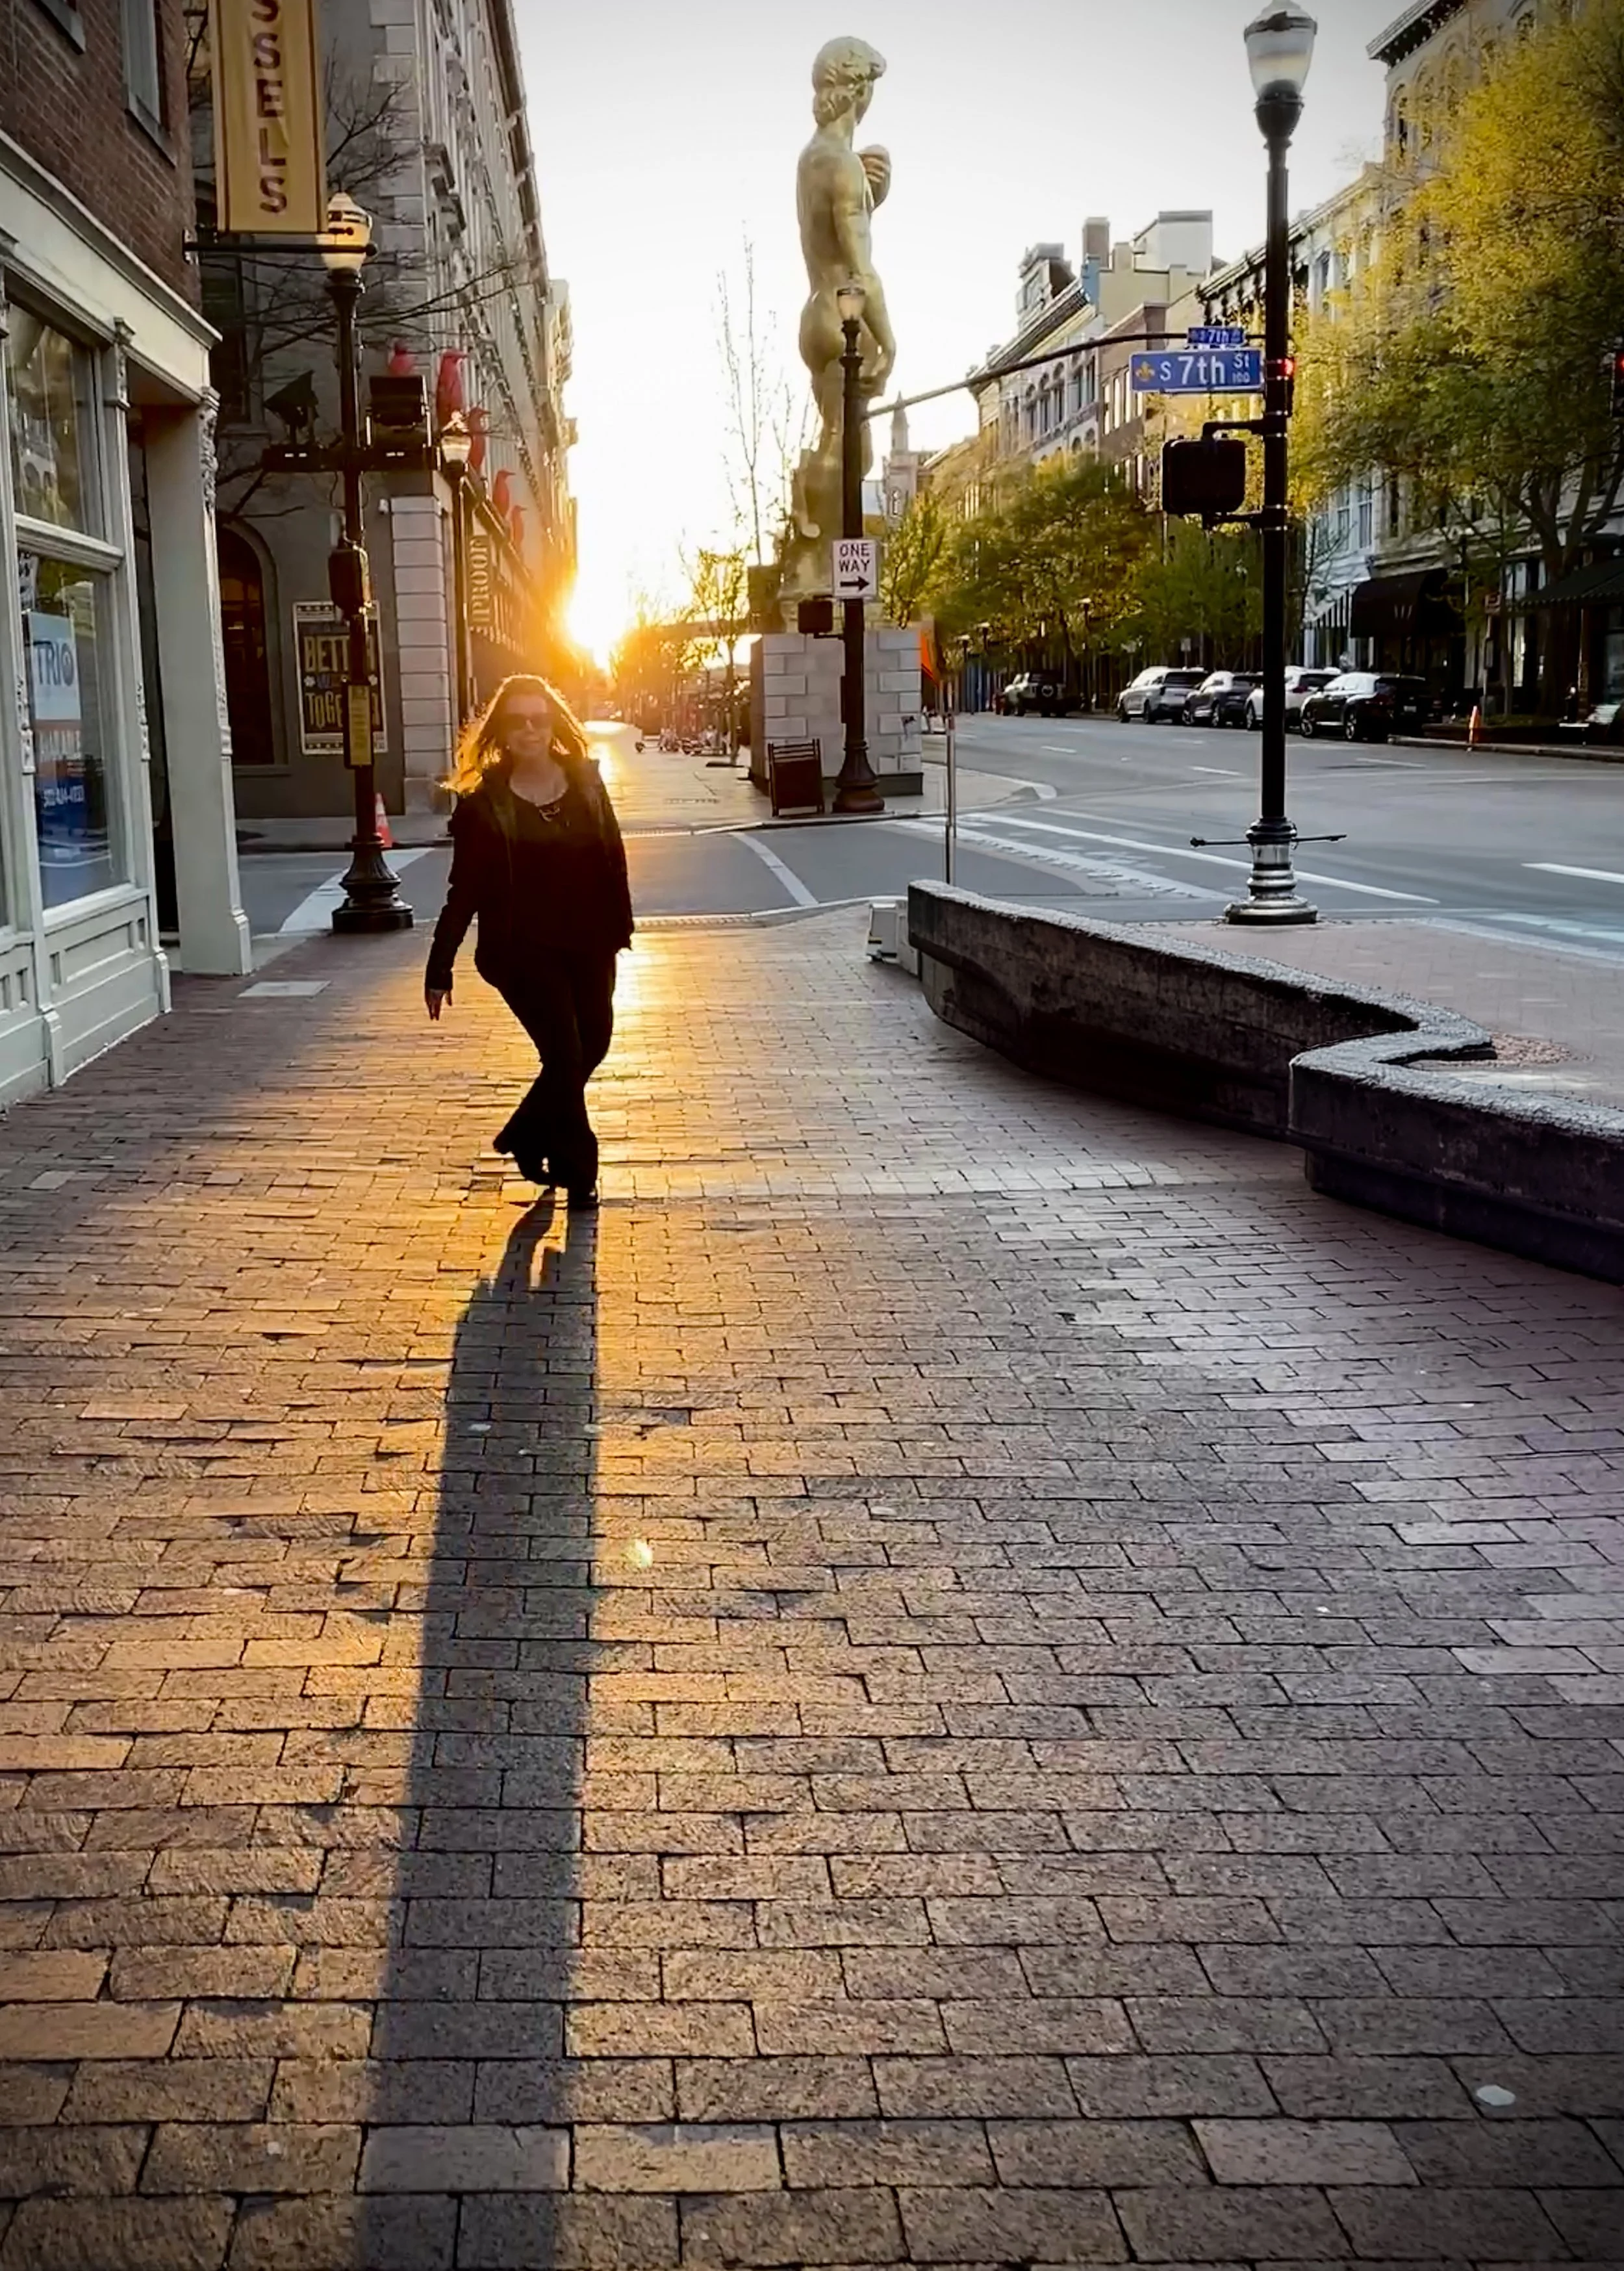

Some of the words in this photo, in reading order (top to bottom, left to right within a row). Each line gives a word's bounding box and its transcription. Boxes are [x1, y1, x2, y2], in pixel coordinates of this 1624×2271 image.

[1160, 361, 1172, 381] S
[1178, 355, 1225, 385] 7th
[1234, 353, 1249, 368] St
[839, 559, 870, 572] WAY
[840, 543, 870, 558] ONE
[470, 536, 490, 615] PROOF
[33, 640, 75, 686] TRIO
